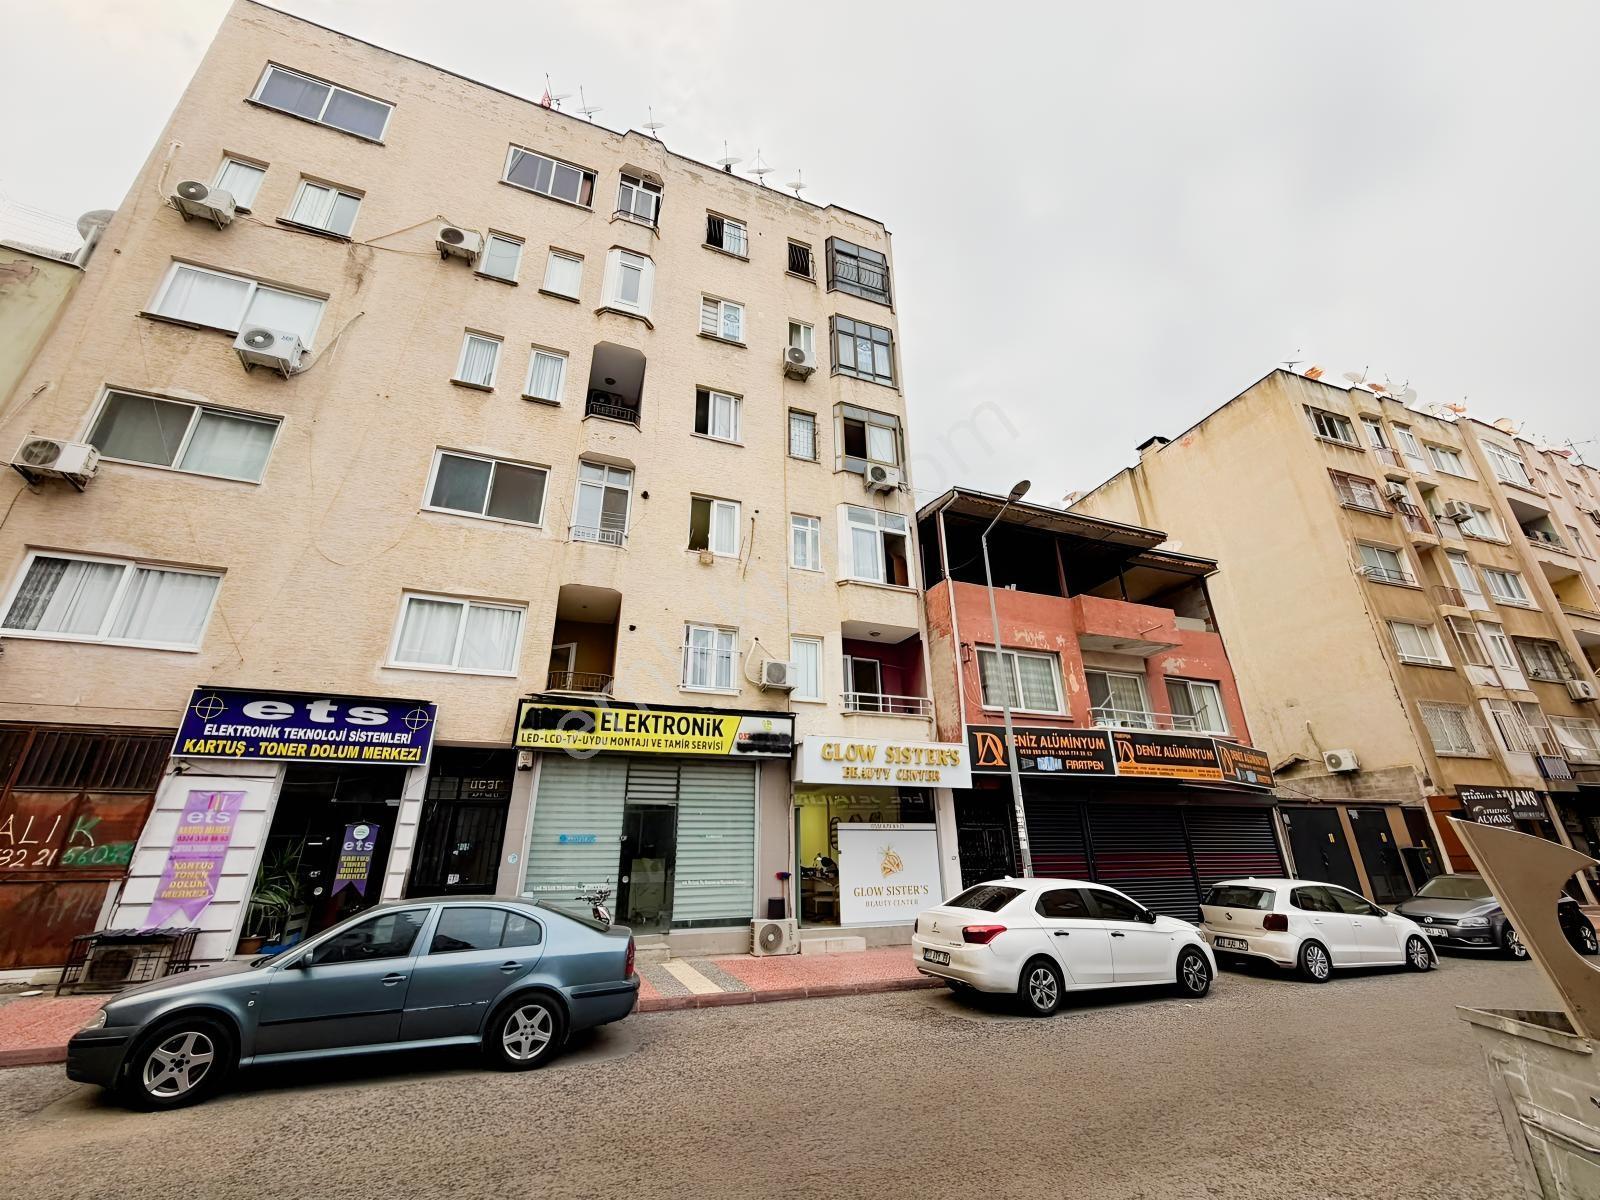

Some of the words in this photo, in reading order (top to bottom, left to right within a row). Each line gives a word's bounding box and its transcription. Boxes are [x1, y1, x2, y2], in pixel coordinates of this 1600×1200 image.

[242, 700, 389, 726] ets
[203, 723, 280, 739] ELEKTRONİK
[283, 727, 347, 741] TEKNOLOJİ
[348, 730, 412, 744] SİSTEMLERİ
[1005, 731, 1038, 748] ENİZ
[1040, 732, 1106, 750] ALÜMİNYUM
[183, 738, 246, 758] KARTUŞ
[259, 741, 308, 757] TONER
[309, 743, 362, 759] DOLUM
[362, 744, 421, 761] MERKEZİ
[610, 736, 649, 747] MONTAJI
[651, 739, 662, 748] VE
[664, 738, 690, 749] TAMİR
[691, 740, 724, 751] SERVİSİ
[1135, 742, 1163, 757] DENİZ
[1163, 744, 1215, 761] ALÜMİNYUM
[821, 742, 877, 762] GLOW
[885, 745, 961, 766] SISTER'S
[842, 766, 891, 780] BEAUTY
[895, 768, 941, 782] CENTER
[187, 809, 232, 824] ets
[1477, 814, 1512, 824] ALYANS
[343, 840, 374, 851] ets
[853, 886, 884, 897] GLOW
[886, 884, 929, 896] SISTER'S
[865, 900, 891, 908] BEAUTY
